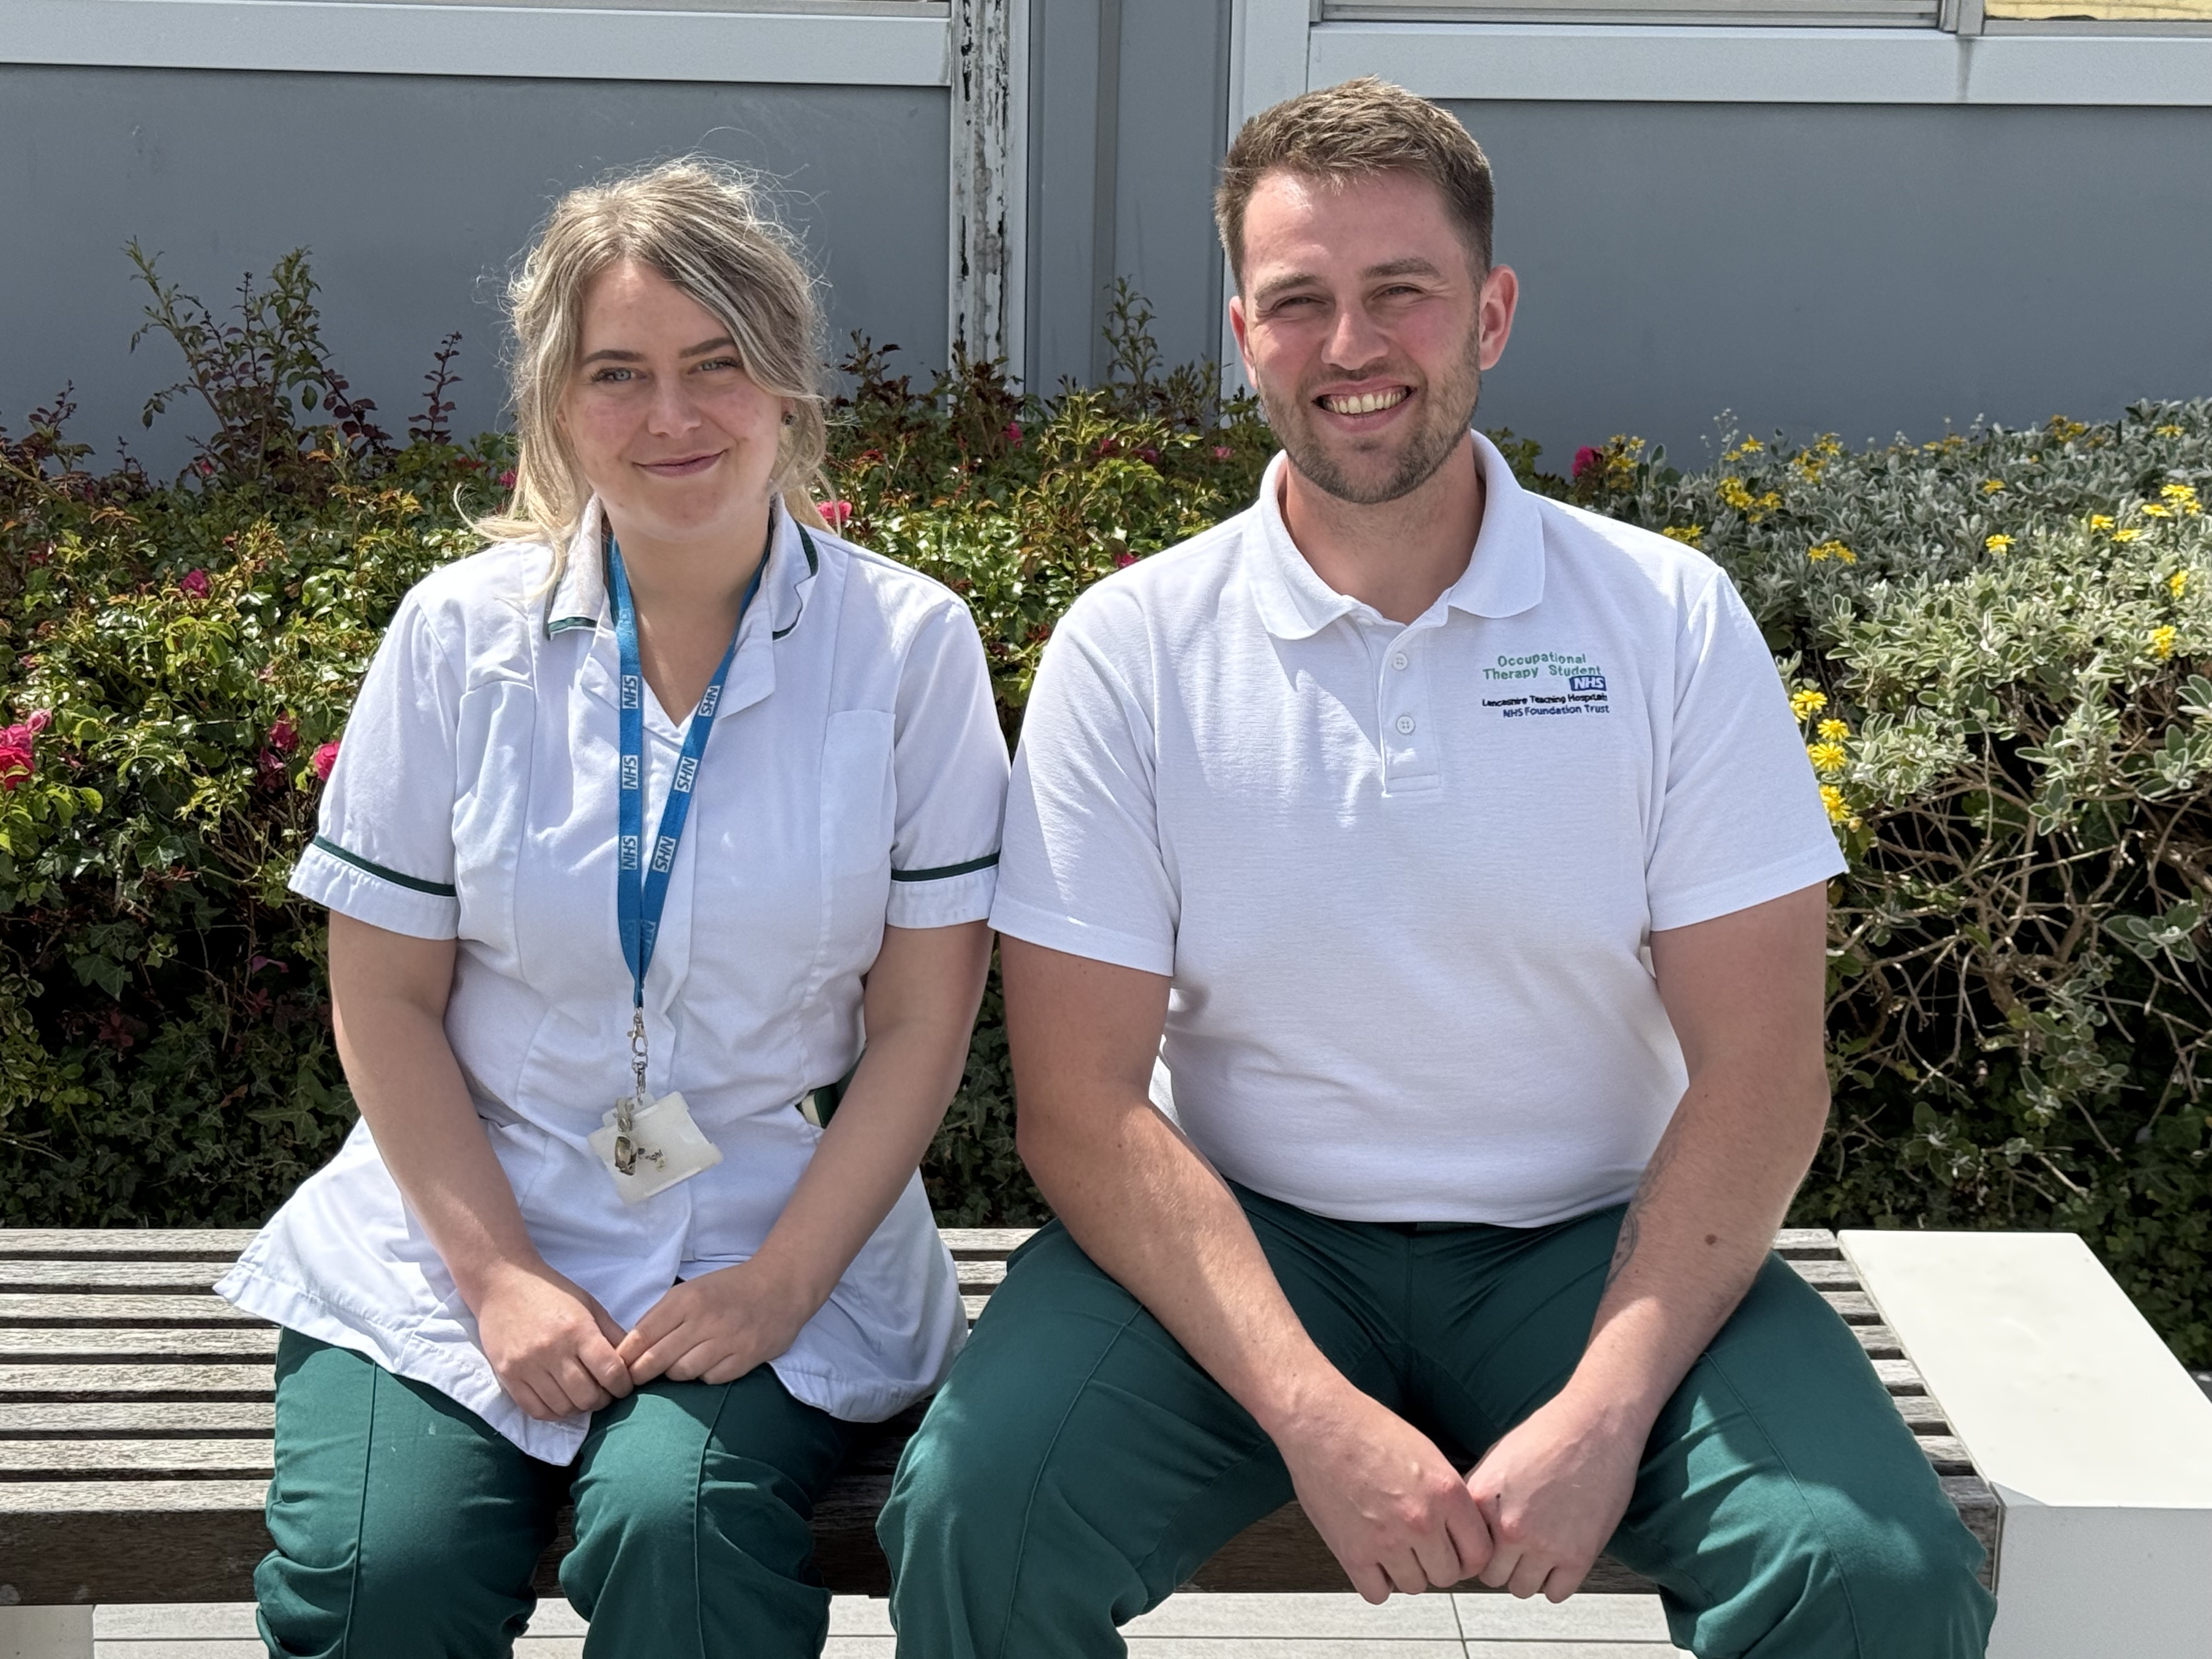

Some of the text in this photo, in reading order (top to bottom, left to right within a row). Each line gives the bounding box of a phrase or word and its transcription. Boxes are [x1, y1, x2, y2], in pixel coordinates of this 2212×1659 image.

[1482, 664, 1601, 680] Therapy Student
[1497, 651, 1587, 668] Occupational
[623, 676, 637, 708] NHS
[1573, 676, 1605, 690] NHS
[700, 687, 719, 716] NHS
[1503, 704, 1610, 718] NHS Foundation Trust
[623, 757, 637, 788] NHS
[676, 758, 696, 791] NHS
[623, 837, 636, 870] NHS
[654, 837, 674, 871] NHS
